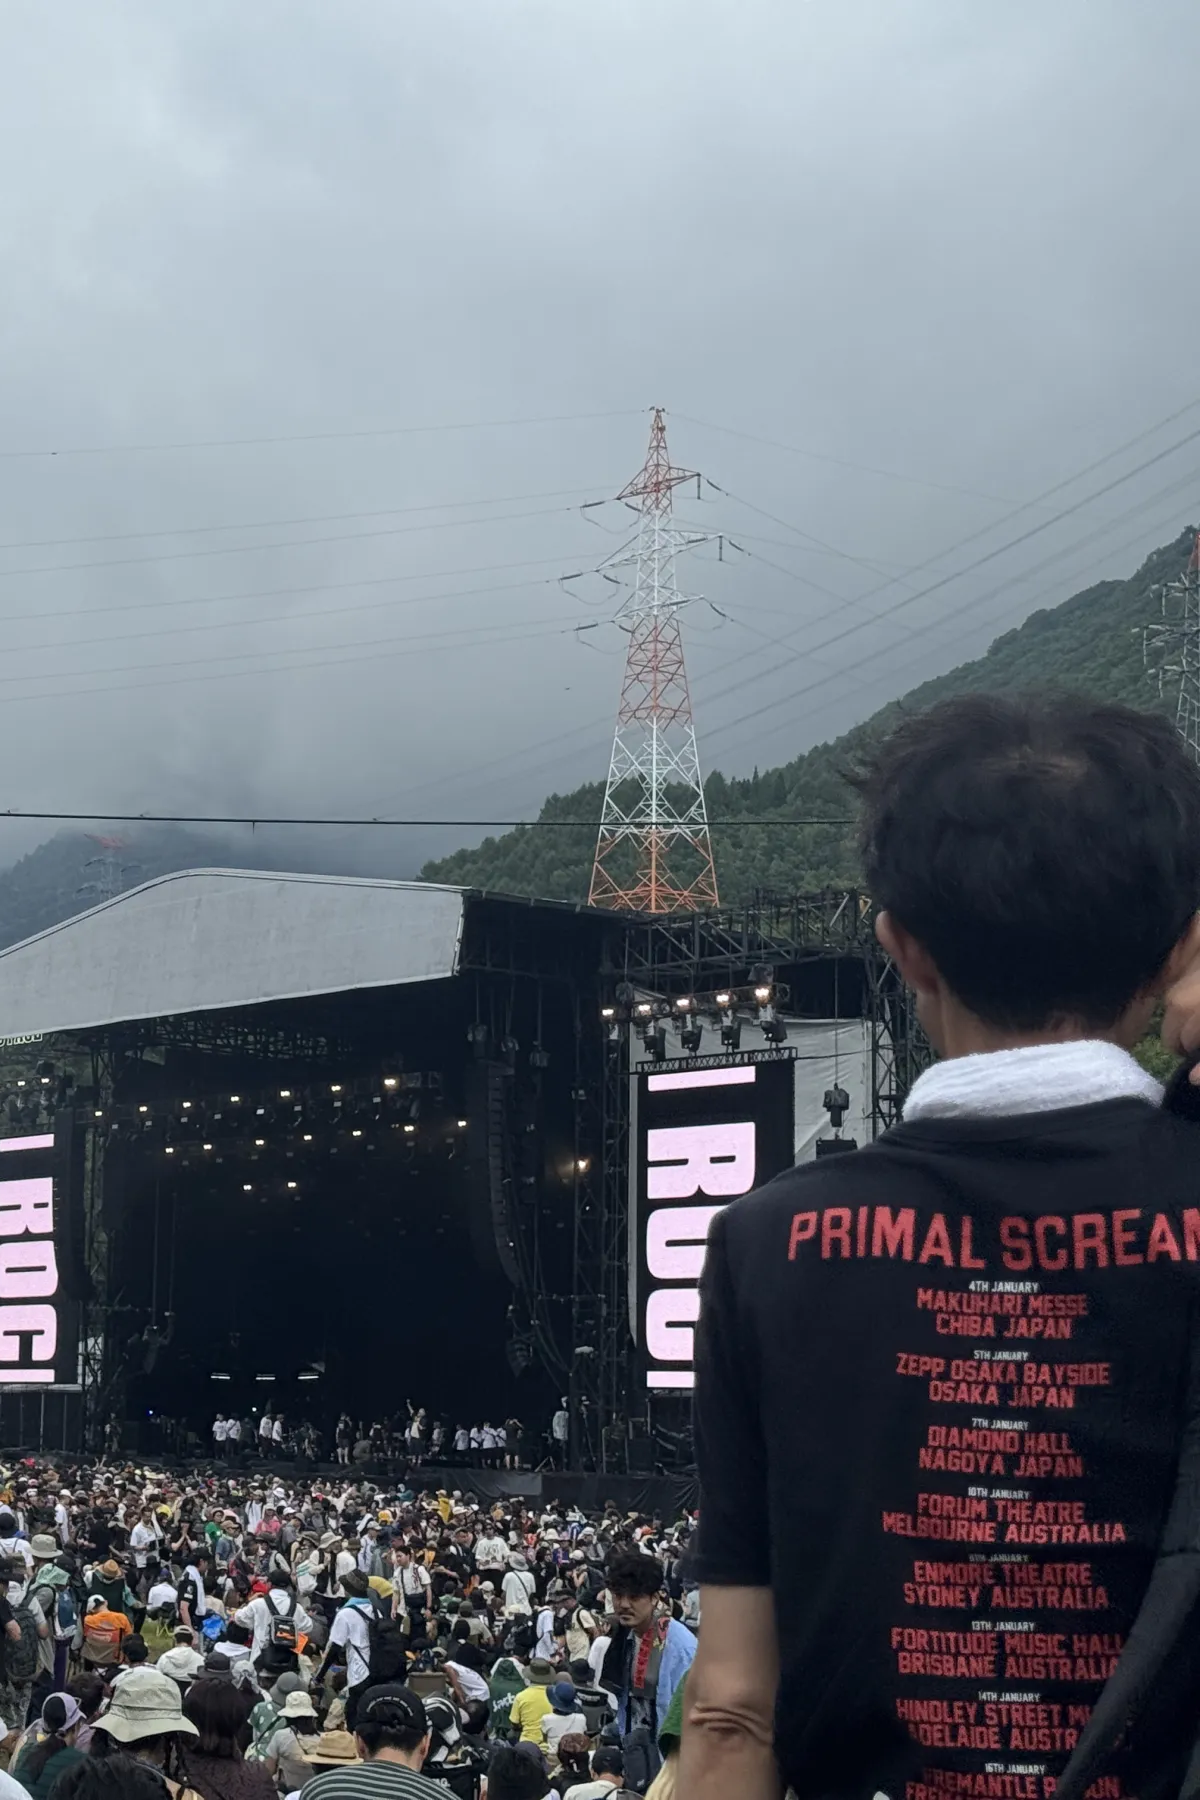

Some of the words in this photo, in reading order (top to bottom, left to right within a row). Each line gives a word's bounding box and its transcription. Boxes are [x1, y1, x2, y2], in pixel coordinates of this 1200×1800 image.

[787, 1205, 985, 1269] PRIMAL
[968, 1281, 989, 1292] 4TH
[991, 1281, 1040, 1293] JANUARY
[916, 1288, 1022, 1315] MAKUHARI
[1027, 1294, 1088, 1316] MESSE
[936, 1313, 995, 1337] CHIBA
[1004, 1317, 1072, 1339] JAPAN
[974, 1350, 989, 1360] 5TH
[992, 1351, 1029, 1361] JANUARY
[896, 1353, 945, 1377] ZEPP
[951, 1359, 1018, 1383] OSAKA
[1023, 1362, 1110, 1385] BAYSIDE
[928, 1380, 1000, 1405] OSAKA
[1007, 1385, 1075, 1408] JAPAN
[972, 1417, 988, 1428] 7TH
[990, 1419, 1029, 1431] JANUARY
[928, 1425, 1019, 1453] DIAMOND
[1024, 1432, 1073, 1454] HALL
[919, 1448, 1005, 1475] NAGOYA
[1014, 1454, 1083, 1477] JAPAN
[968, 1487, 988, 1497] 10TH
[990, 1489, 1030, 1499] JANUARY
[917, 1493, 987, 1520] FORUM
[996, 1500, 1086, 1524] THEATRE
[882, 1511, 997, 1543] MELBOURNE
[1004, 1522, 1126, 1544] AUSTRALIA
[914, 1559, 995, 1585] ENMORE
[1002, 1563, 1092, 1585] THEATRE
[903, 1582, 980, 1608] SYDNEY
[991, 1586, 1109, 1609] AUSTRALIA
[971, 1621, 991, 1631] 13TH
[994, 1621, 1035, 1632] JANUARY
[890, 1627, 998, 1654] FORTITUDE
[1004, 1632, 1066, 1656] MUSIC
[898, 1652, 998, 1678] BRISBANE
[979, 1691, 997, 1701] 14TH
[1000, 1692, 1041, 1702] JANUARY
[896, 1699, 977, 1724] HINDLEY
[984, 1703, 1062, 1727] STREET
[1009, 1728, 1078, 1750] AUSTR
[1006, 1764, 1045, 1775] JANUARY
